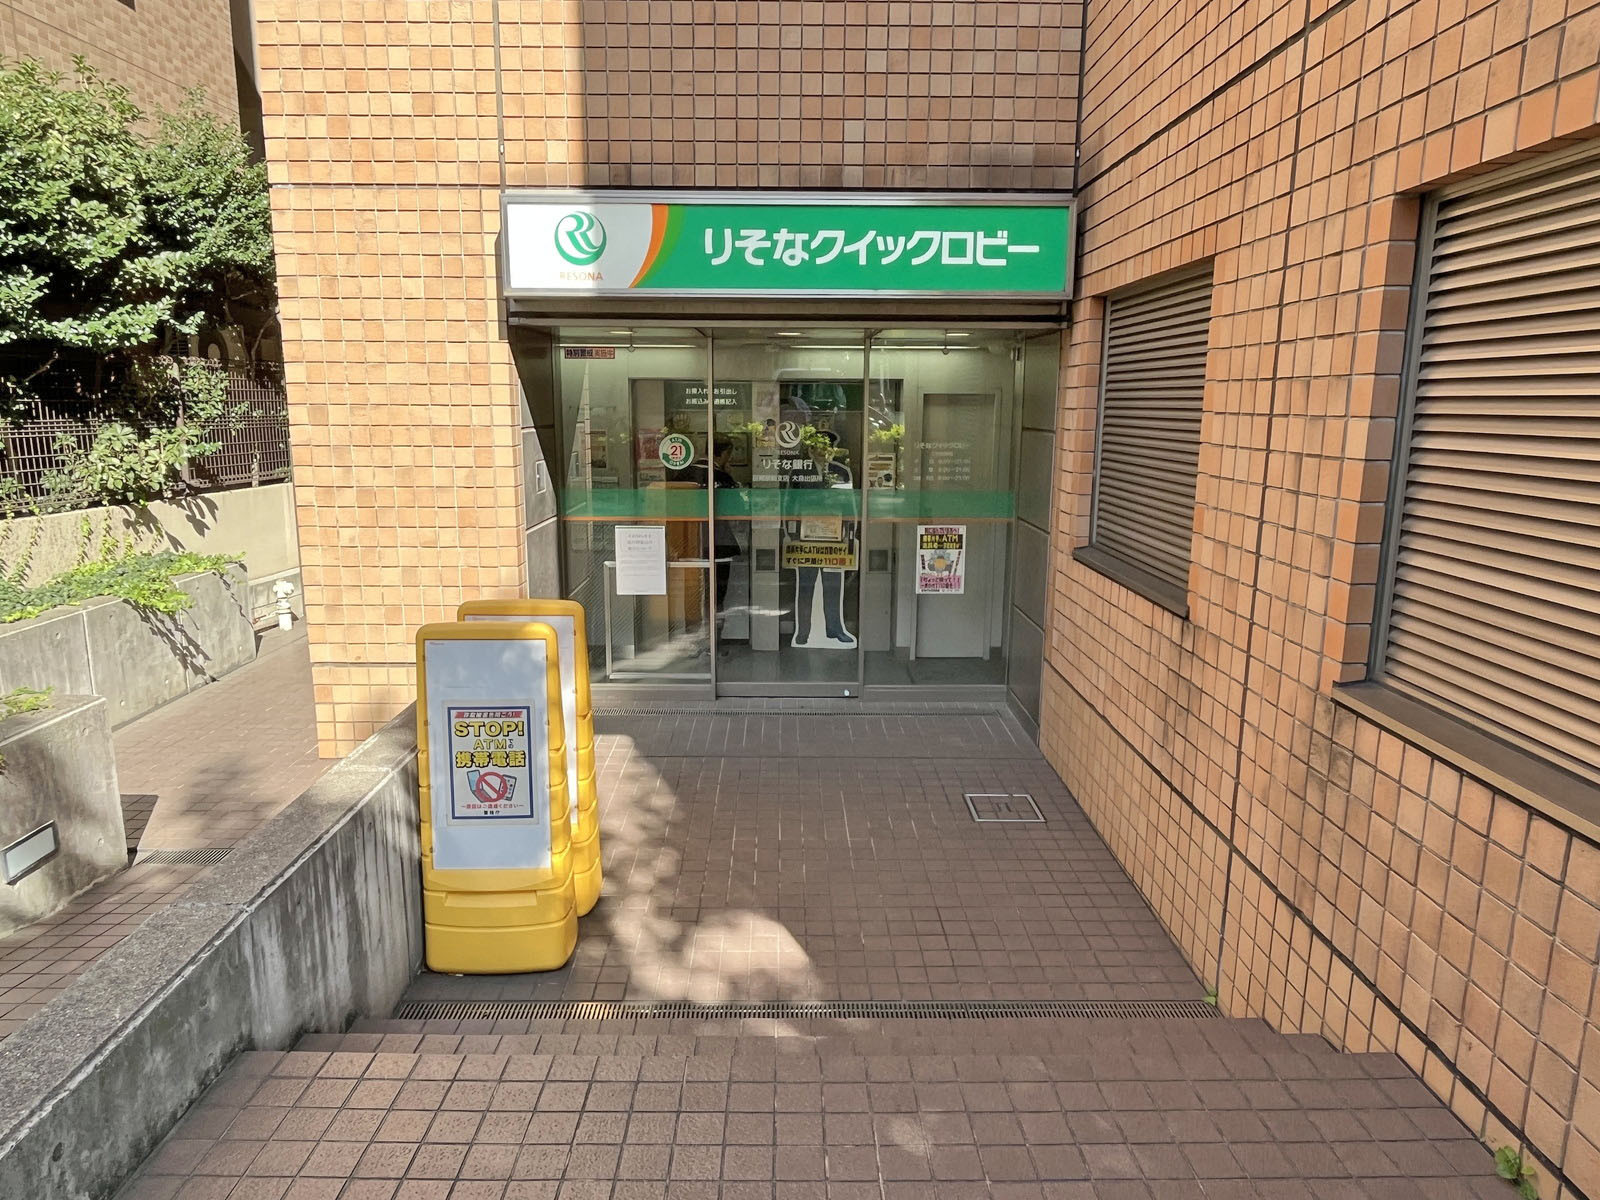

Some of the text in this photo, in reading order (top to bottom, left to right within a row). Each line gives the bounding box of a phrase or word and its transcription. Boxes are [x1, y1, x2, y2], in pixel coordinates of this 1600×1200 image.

[704, 228, 1039, 267] りそなクイックロビー
[559, 271, 604, 281] RESONA
[670, 445, 682, 456] 21
[762, 459, 813, 470] りそな銀行
[454, 721, 525, 737] STOP!
[455, 751, 526, 768] 携帯電話
